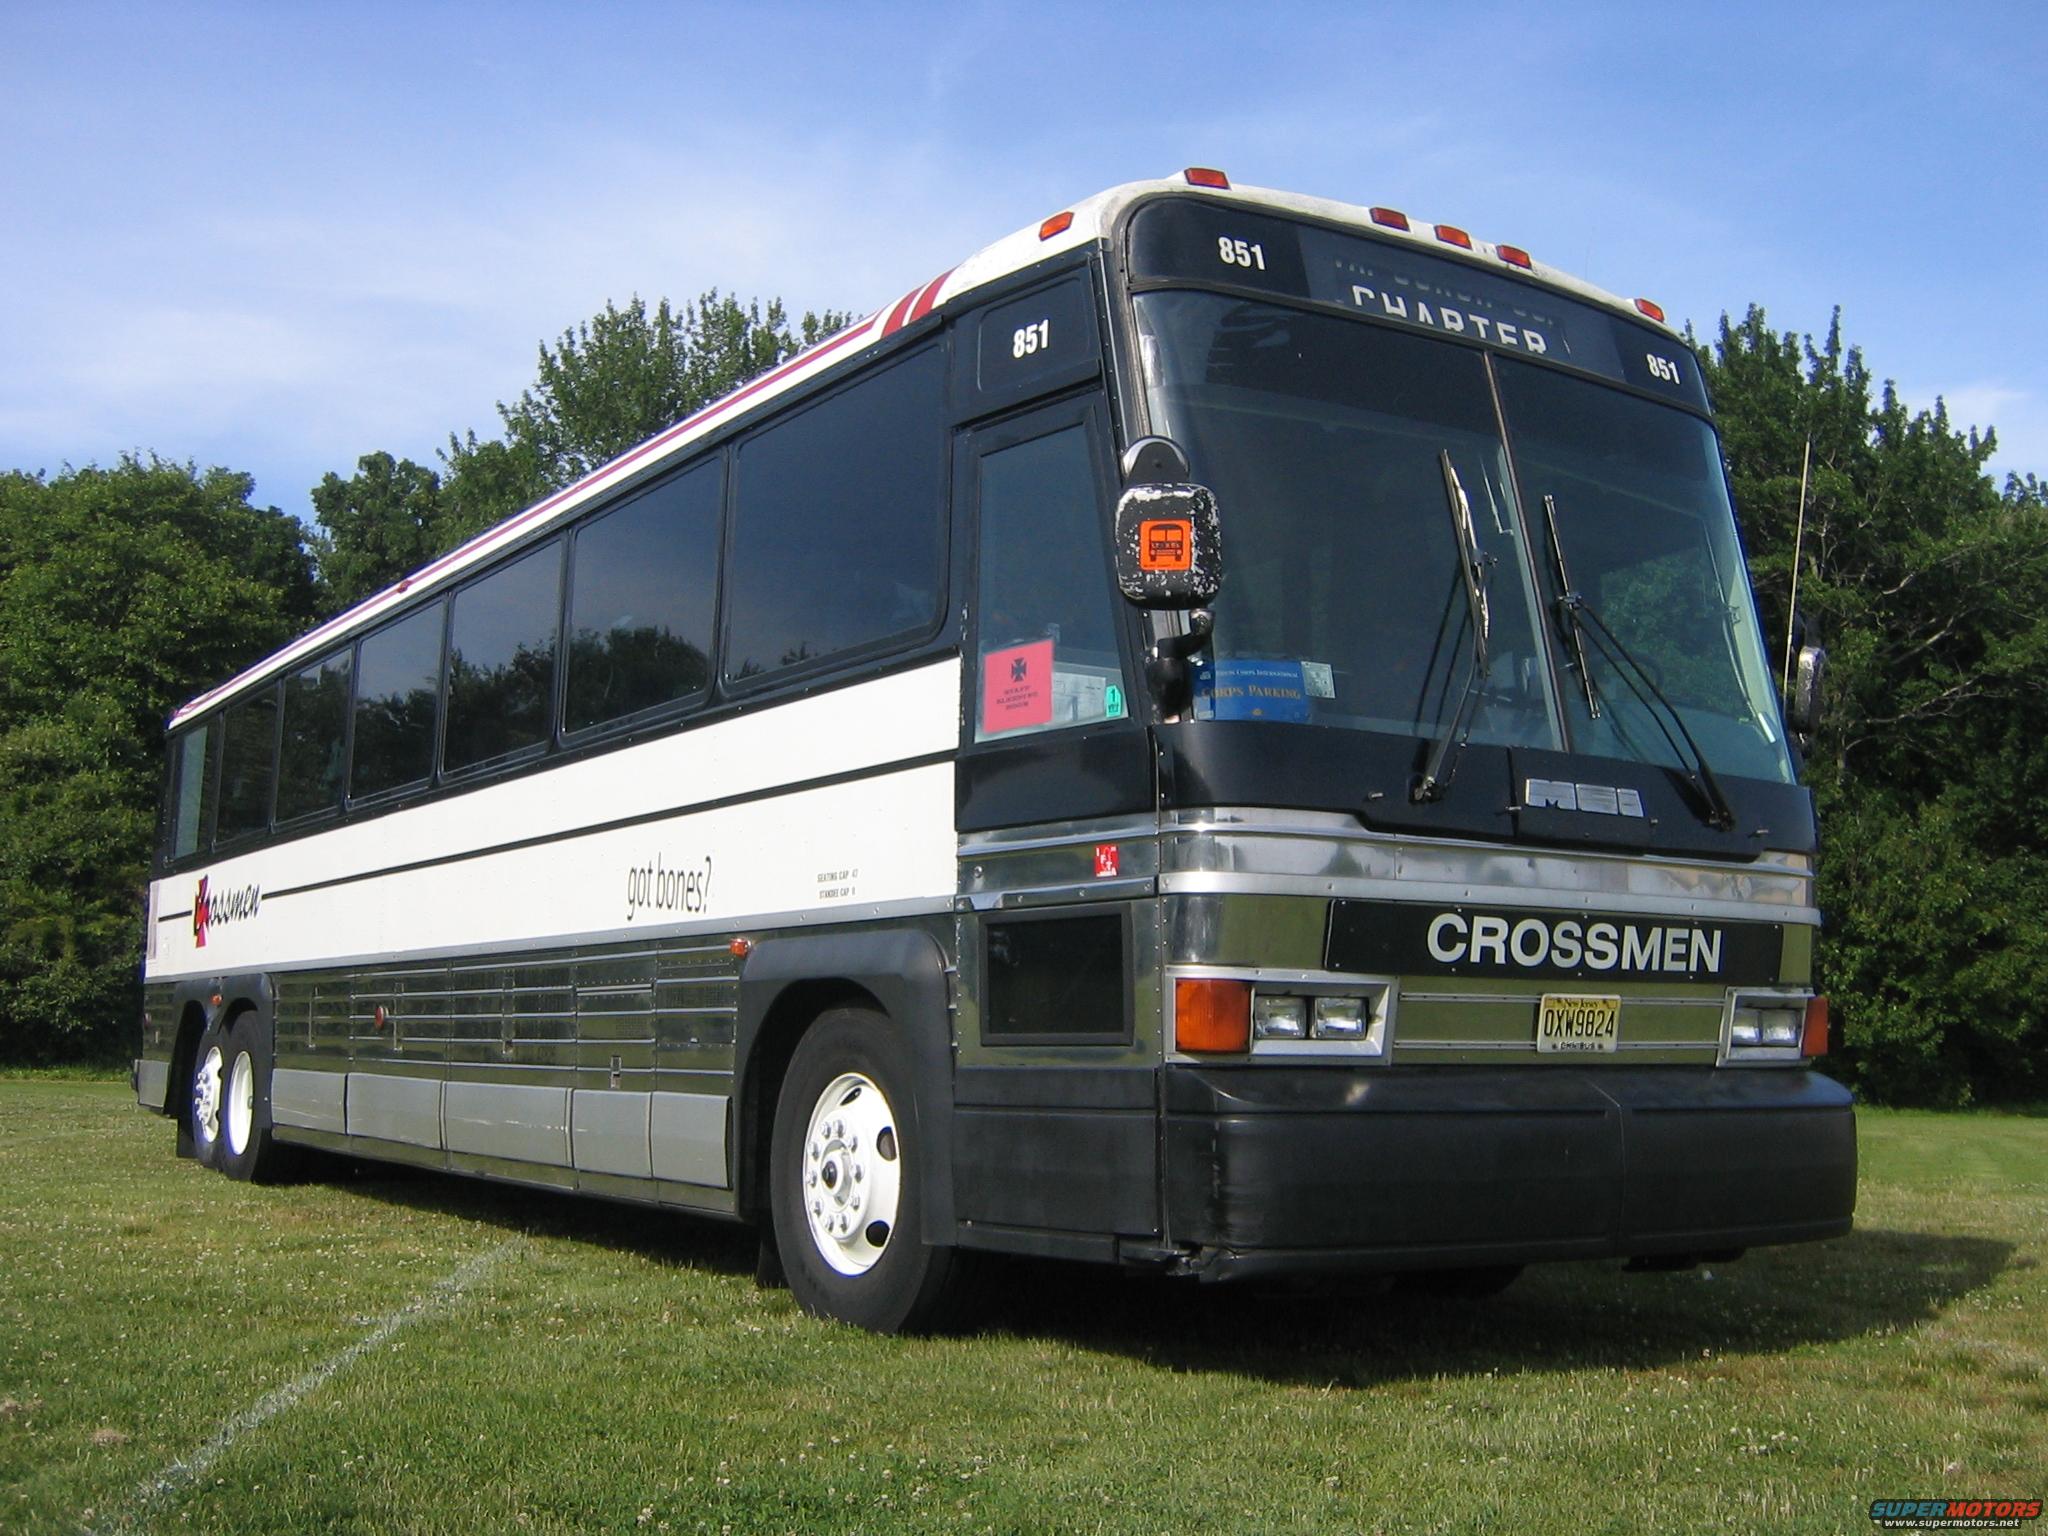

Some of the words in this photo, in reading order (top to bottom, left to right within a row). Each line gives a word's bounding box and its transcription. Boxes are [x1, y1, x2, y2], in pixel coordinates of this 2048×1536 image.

[1218, 236, 1266, 271] 851
[1012, 318, 1049, 359] 851
[1352, 284, 1548, 355] CHARTER
[1646, 353, 1681, 386] 851
[1248, 684, 1301, 700] PARKING
[627, 860, 652, 921] got
[656, 851, 711, 914] bones?
[1426, 912, 1722, 973] CROSSMEN
